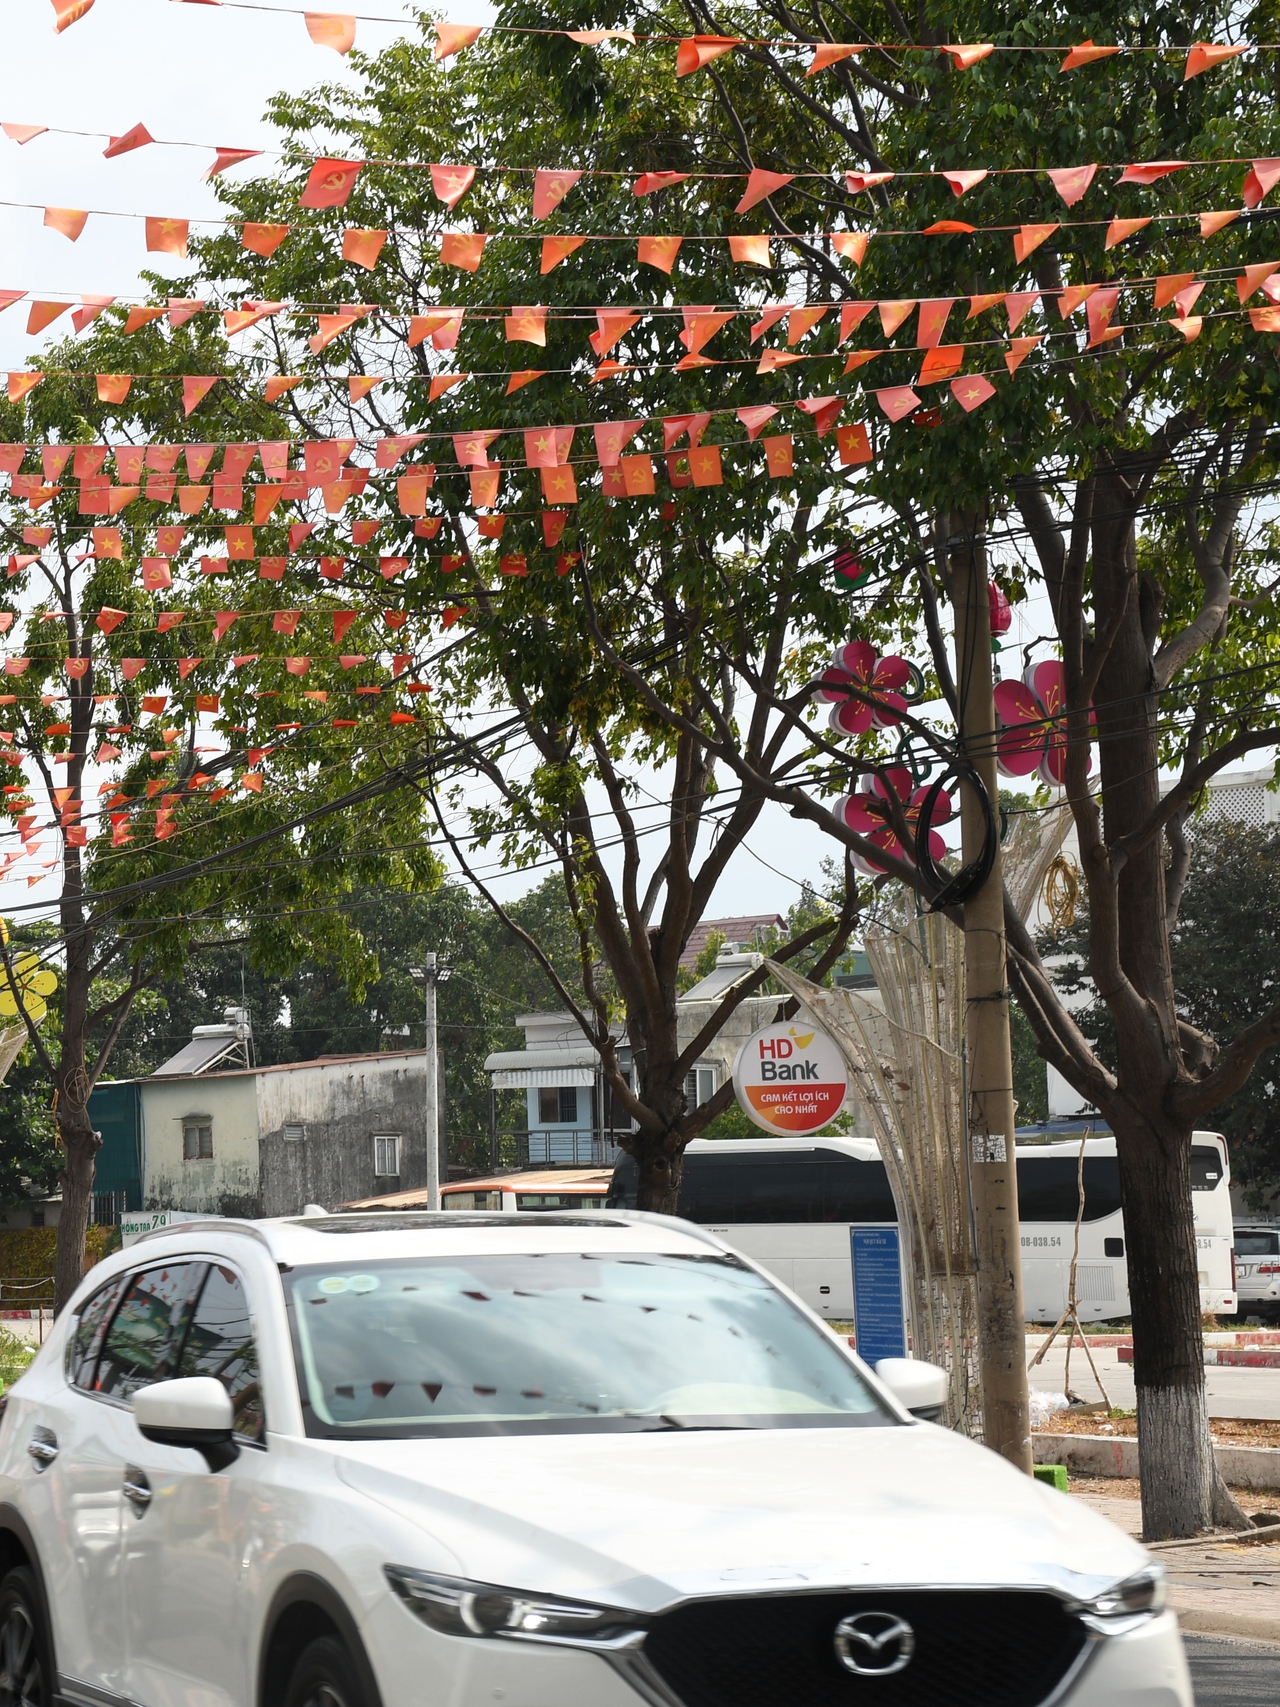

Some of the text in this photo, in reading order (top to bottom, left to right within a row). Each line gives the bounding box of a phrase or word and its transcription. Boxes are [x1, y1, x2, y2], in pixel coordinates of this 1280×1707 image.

[759, 1038, 793, 1059] HD
[761, 1060, 819, 1081] Bank
[761, 1093, 780, 1103] CAM
[782, 1090, 798, 1102] KẾT
[815, 1090, 829, 1101] ÍCH
[774, 1102, 818, 1114] CAO NHẤT
[1020, 1236, 1061, 1247] 0B-038.54
